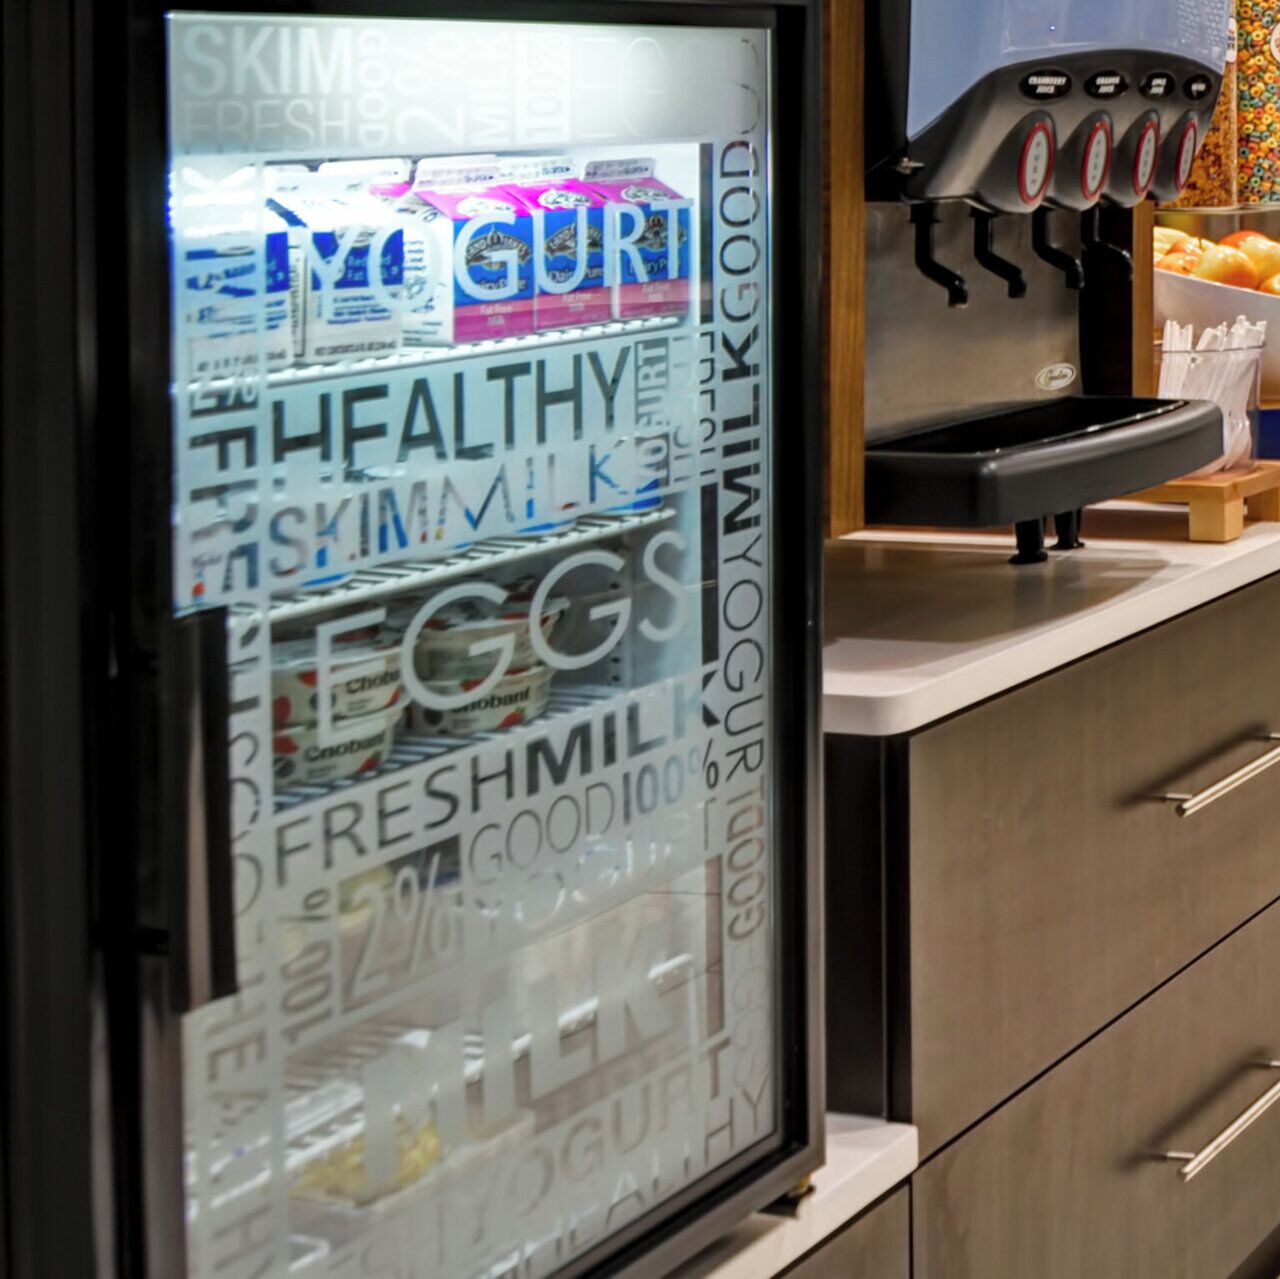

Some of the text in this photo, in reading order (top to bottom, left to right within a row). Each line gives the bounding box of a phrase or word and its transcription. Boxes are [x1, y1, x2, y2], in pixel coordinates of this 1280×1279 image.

[181, 24, 352, 97] SKIM
[287, 198, 694, 318] YOGURT
[719, 138, 761, 323] GOOD
[271, 345, 632, 483] HEALTHY
[722, 323, 760, 536] MILK
[269, 480, 428, 577] SKIM
[316, 529, 688, 746] EGGS
[723, 533, 765, 806] YOGURT
[525, 669, 721, 798] MILK
[276, 746, 515, 888] FRESH
[468, 782, 615, 885] GOOD
